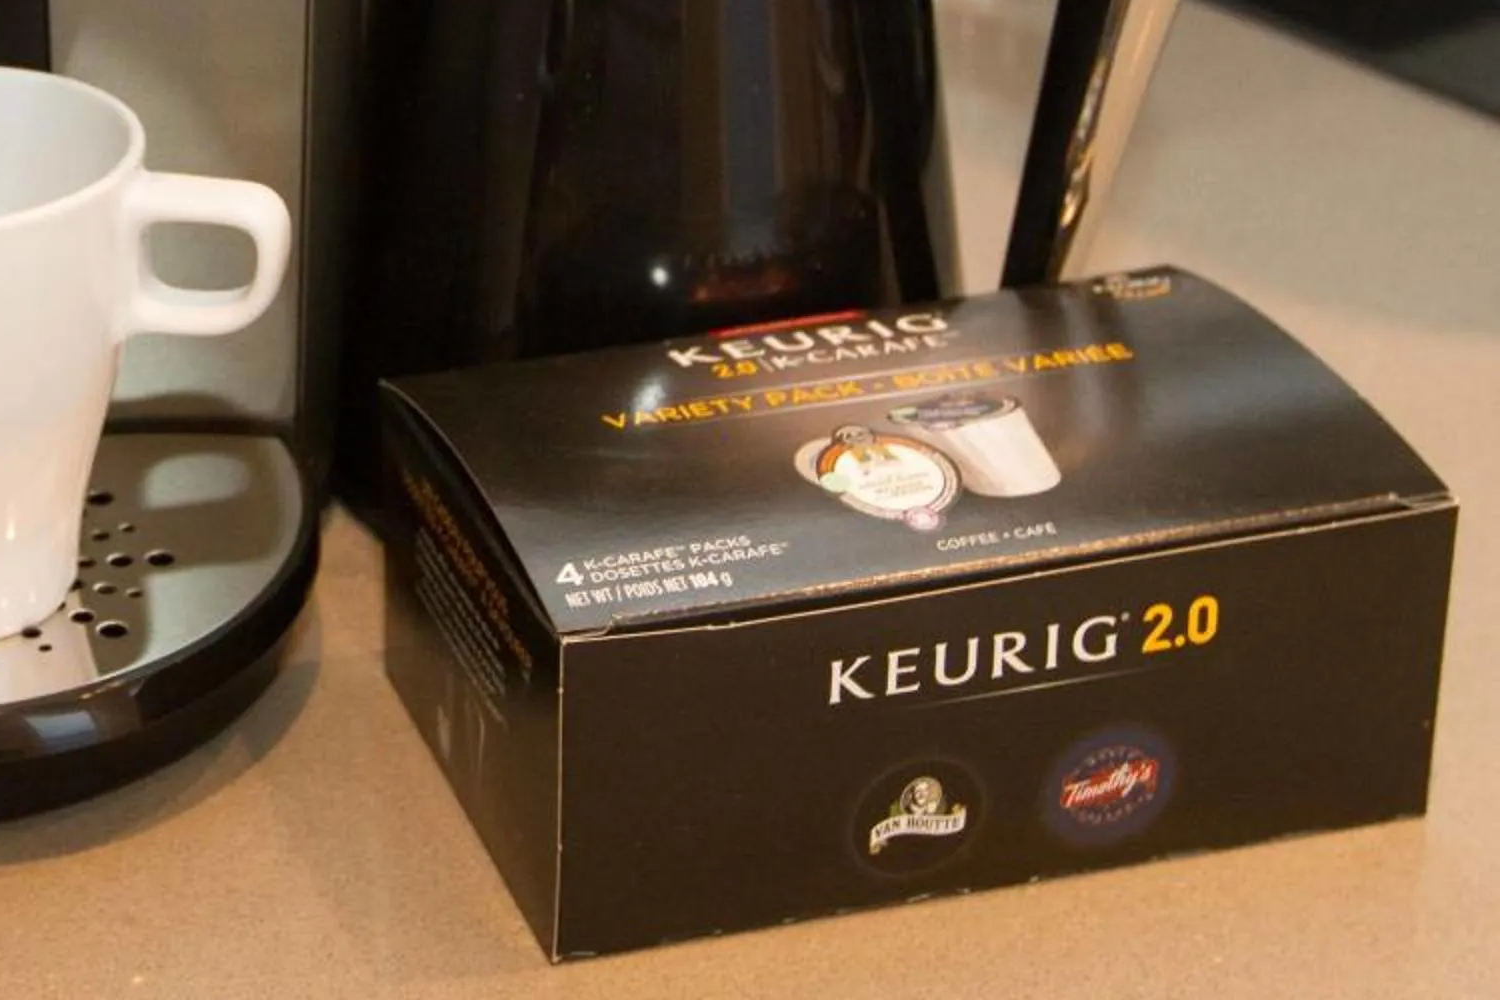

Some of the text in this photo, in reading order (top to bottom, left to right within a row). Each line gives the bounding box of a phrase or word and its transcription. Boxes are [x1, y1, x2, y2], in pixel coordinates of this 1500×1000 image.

[667, 313, 948, 368] KEURIG
[601, 396, 753, 430] VARIETY
[765, 380, 864, 408] PACK
[556, 562, 585, 586] 4
[690, 534, 752, 553] PACKS
[936, 532, 1000, 551] COFFEE
[564, 591, 591, 609] NET
[623, 580, 664, 601] POIDS
[663, 574, 689, 595] NET
[590, 559, 685, 584] DOSETTES
[829, 596, 1219, 704] KEURIG 2.0
[1063, 760, 1154, 808] Timothy's
